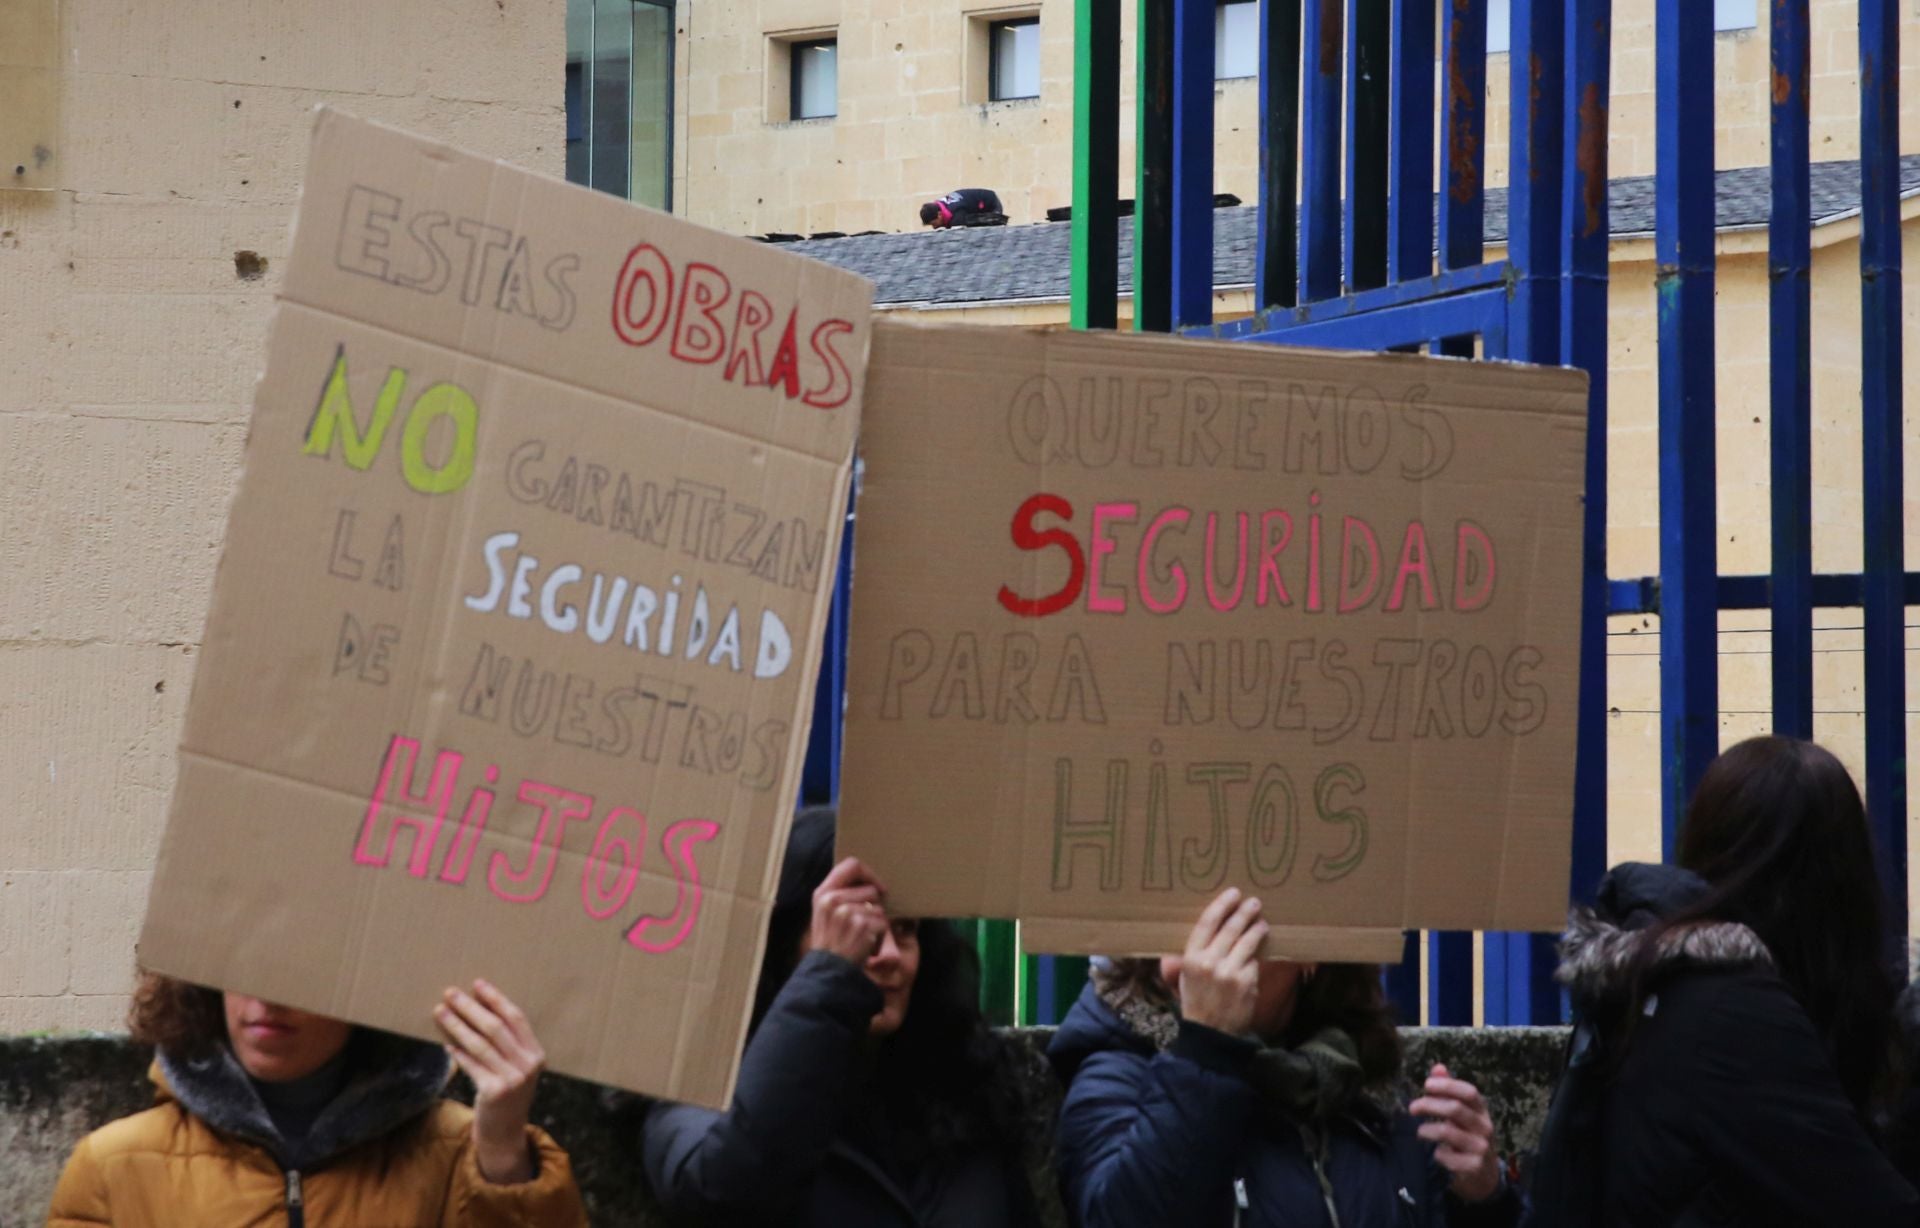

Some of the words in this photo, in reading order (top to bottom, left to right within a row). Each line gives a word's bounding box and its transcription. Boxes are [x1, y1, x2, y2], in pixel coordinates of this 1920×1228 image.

[337, 184, 580, 332] ESTAS
[612, 243, 854, 409] OBRAS
[303, 343, 479, 494] NO
[1007, 374, 1456, 482] QUEREMOS
[328, 509, 404, 592] LA
[332, 613, 398, 686] DE
[459, 643, 787, 792] NUESTROS
[879, 629, 1108, 725] PARA
[1163, 638, 1548, 746] NUESTROS
